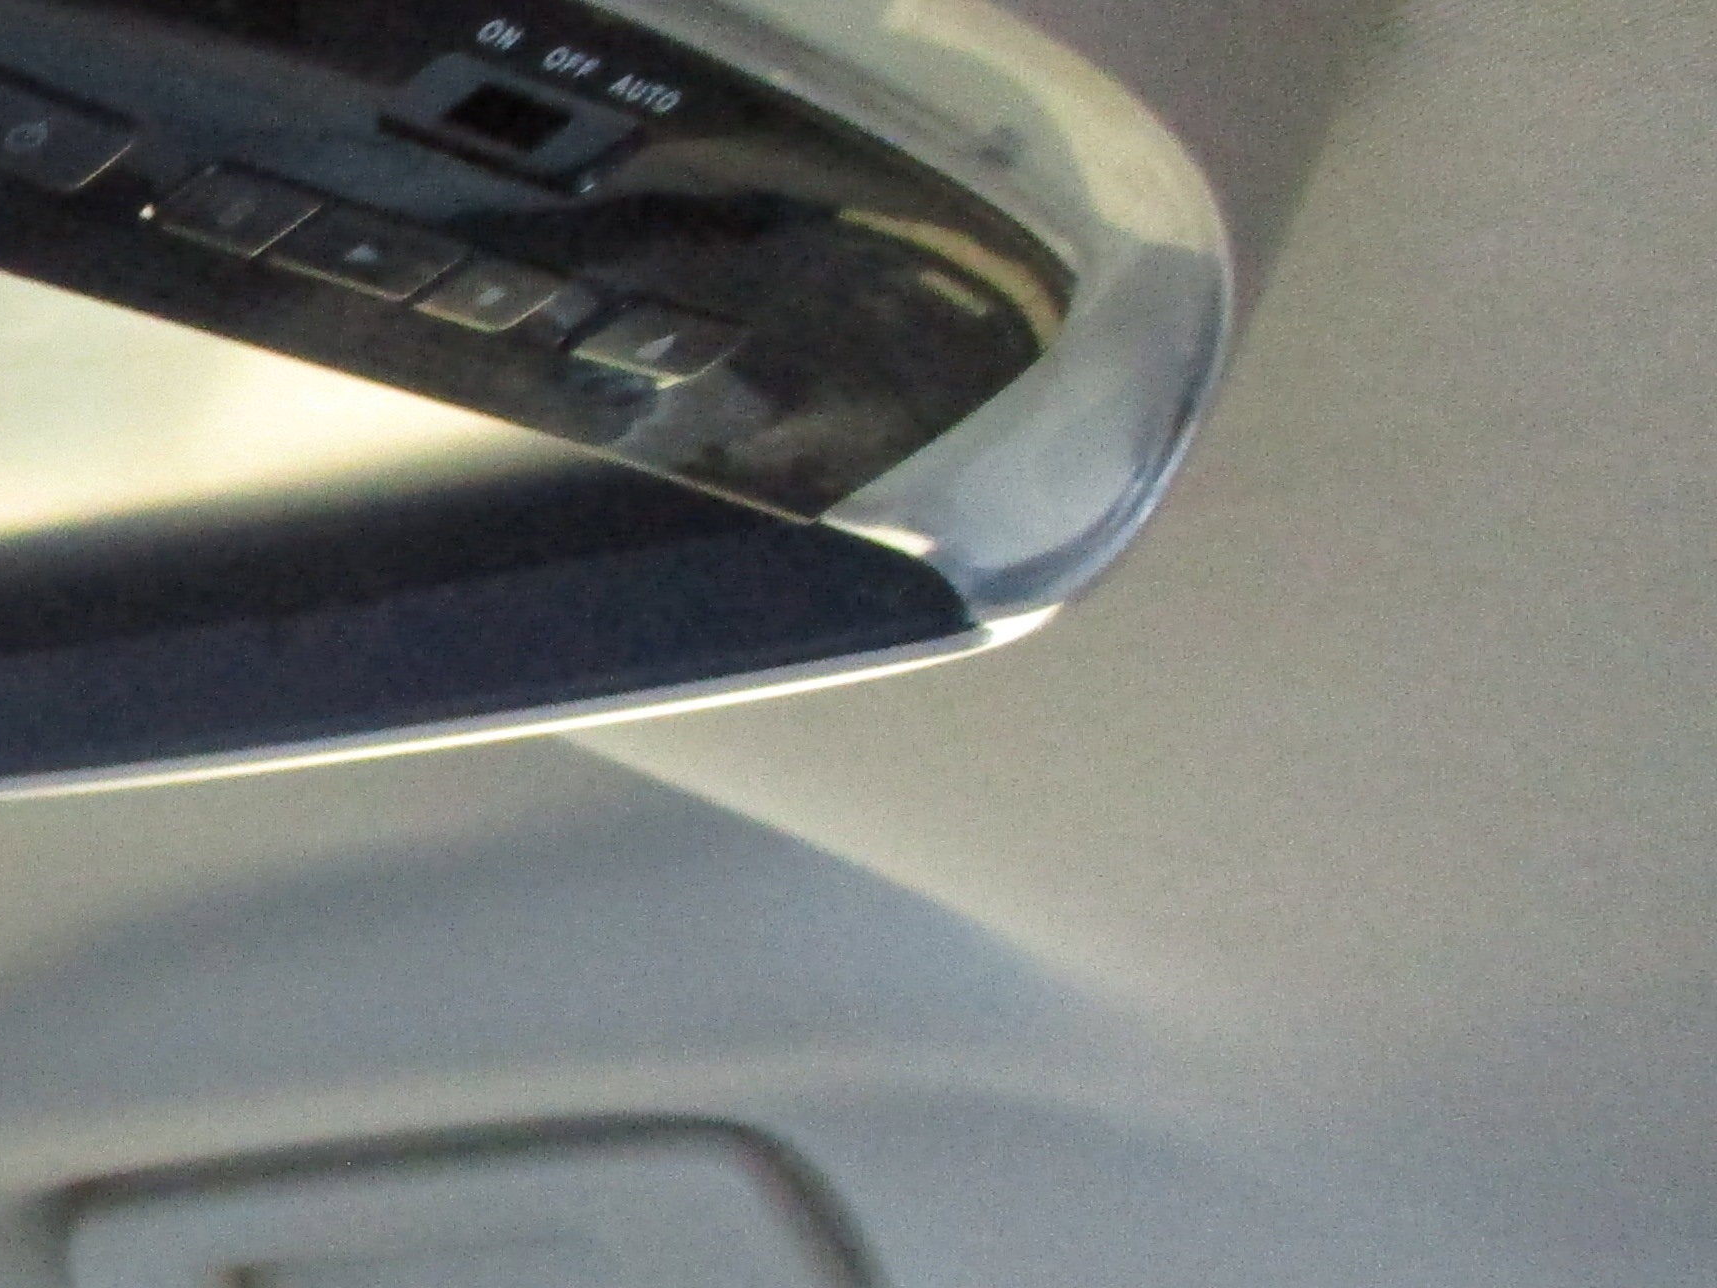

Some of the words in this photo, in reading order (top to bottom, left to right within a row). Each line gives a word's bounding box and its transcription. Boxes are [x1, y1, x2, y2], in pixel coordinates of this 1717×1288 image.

[475, 18, 525, 50] ON
[542, 45, 601, 79] OFF
[609, 73, 683, 113] AUTO
